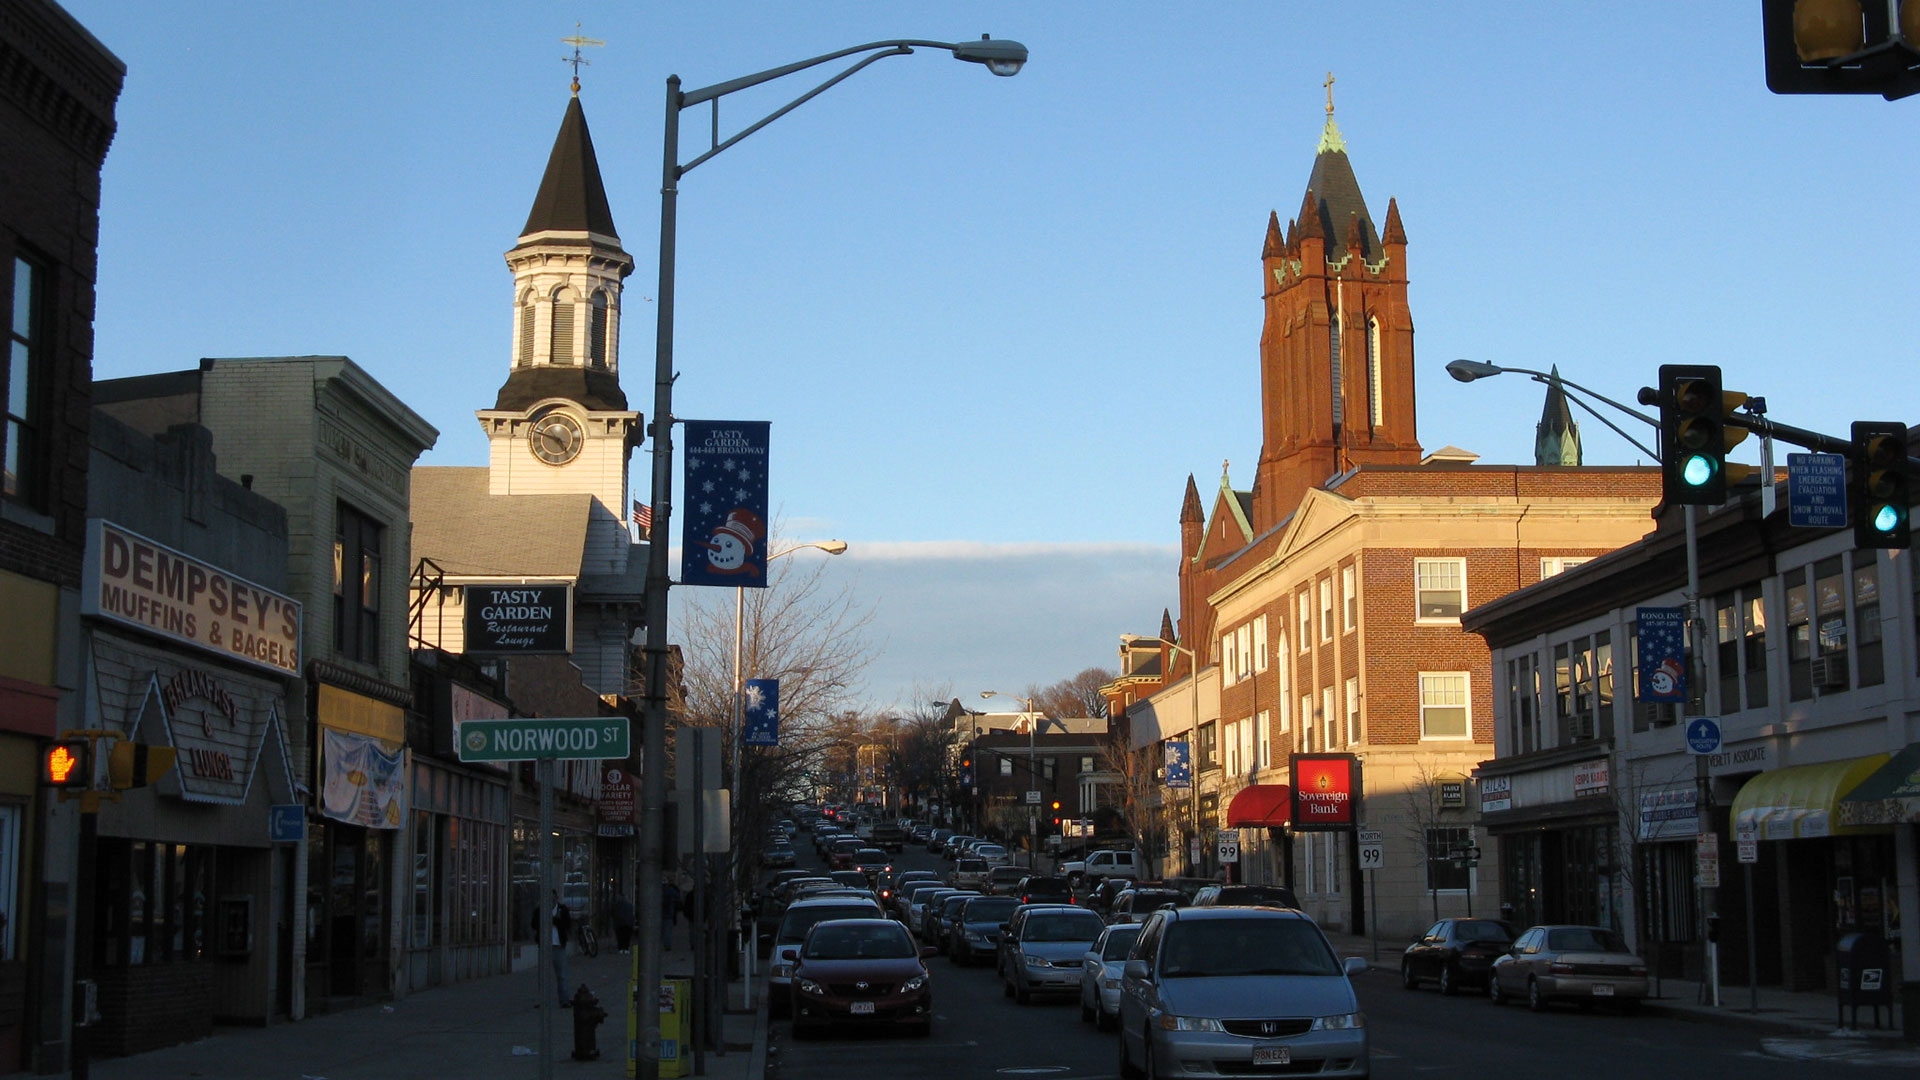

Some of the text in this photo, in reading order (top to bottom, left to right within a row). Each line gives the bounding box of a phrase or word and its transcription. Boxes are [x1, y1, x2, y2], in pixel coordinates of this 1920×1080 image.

[711, 430, 744, 439] TASTY
[704, 438, 750, 447] GARDEN
[717, 447, 765, 455] BROADWAY
[1796, 456, 1836, 465] NO PARKING
[1790, 465, 1842, 475] WHEN FLASHING
[1798, 475, 1836, 485] EMERGENCY
[1798, 485, 1837, 494] EVACUATION
[1811, 495, 1825, 504] AND
[1793, 505, 1843, 514] SNOW REMOVAL
[1808, 515, 1829, 524] ROUTE
[104, 530, 297, 641] DEMPSEY'S
[490, 590, 542, 604] TASTY
[481, 606, 552, 620] GARDEN
[103, 583, 298, 670] MUFFINS & BAGELS
[486, 621, 548, 633] Restaurant
[495, 633, 535, 648] Lounge
[165, 670, 240, 728] BREAKFAST
[201, 709, 213, 737] &
[494, 727, 619, 752] NORWOOD ST
[190, 747, 233, 780] LUNCH
[1707, 753, 1730, 767] VERETT
[1591, 770, 1608, 783] KARATE
[1484, 776, 1507, 792] ATLAS
[600, 791, 632, 799] VARIETY
[1298, 790, 1348, 803] Sovereign
[1310, 803, 1339, 814] Bank
[1360, 832, 1381, 840] NORTH
[1220, 846, 1236, 857] 99
[1363, 849, 1380, 863] 99
